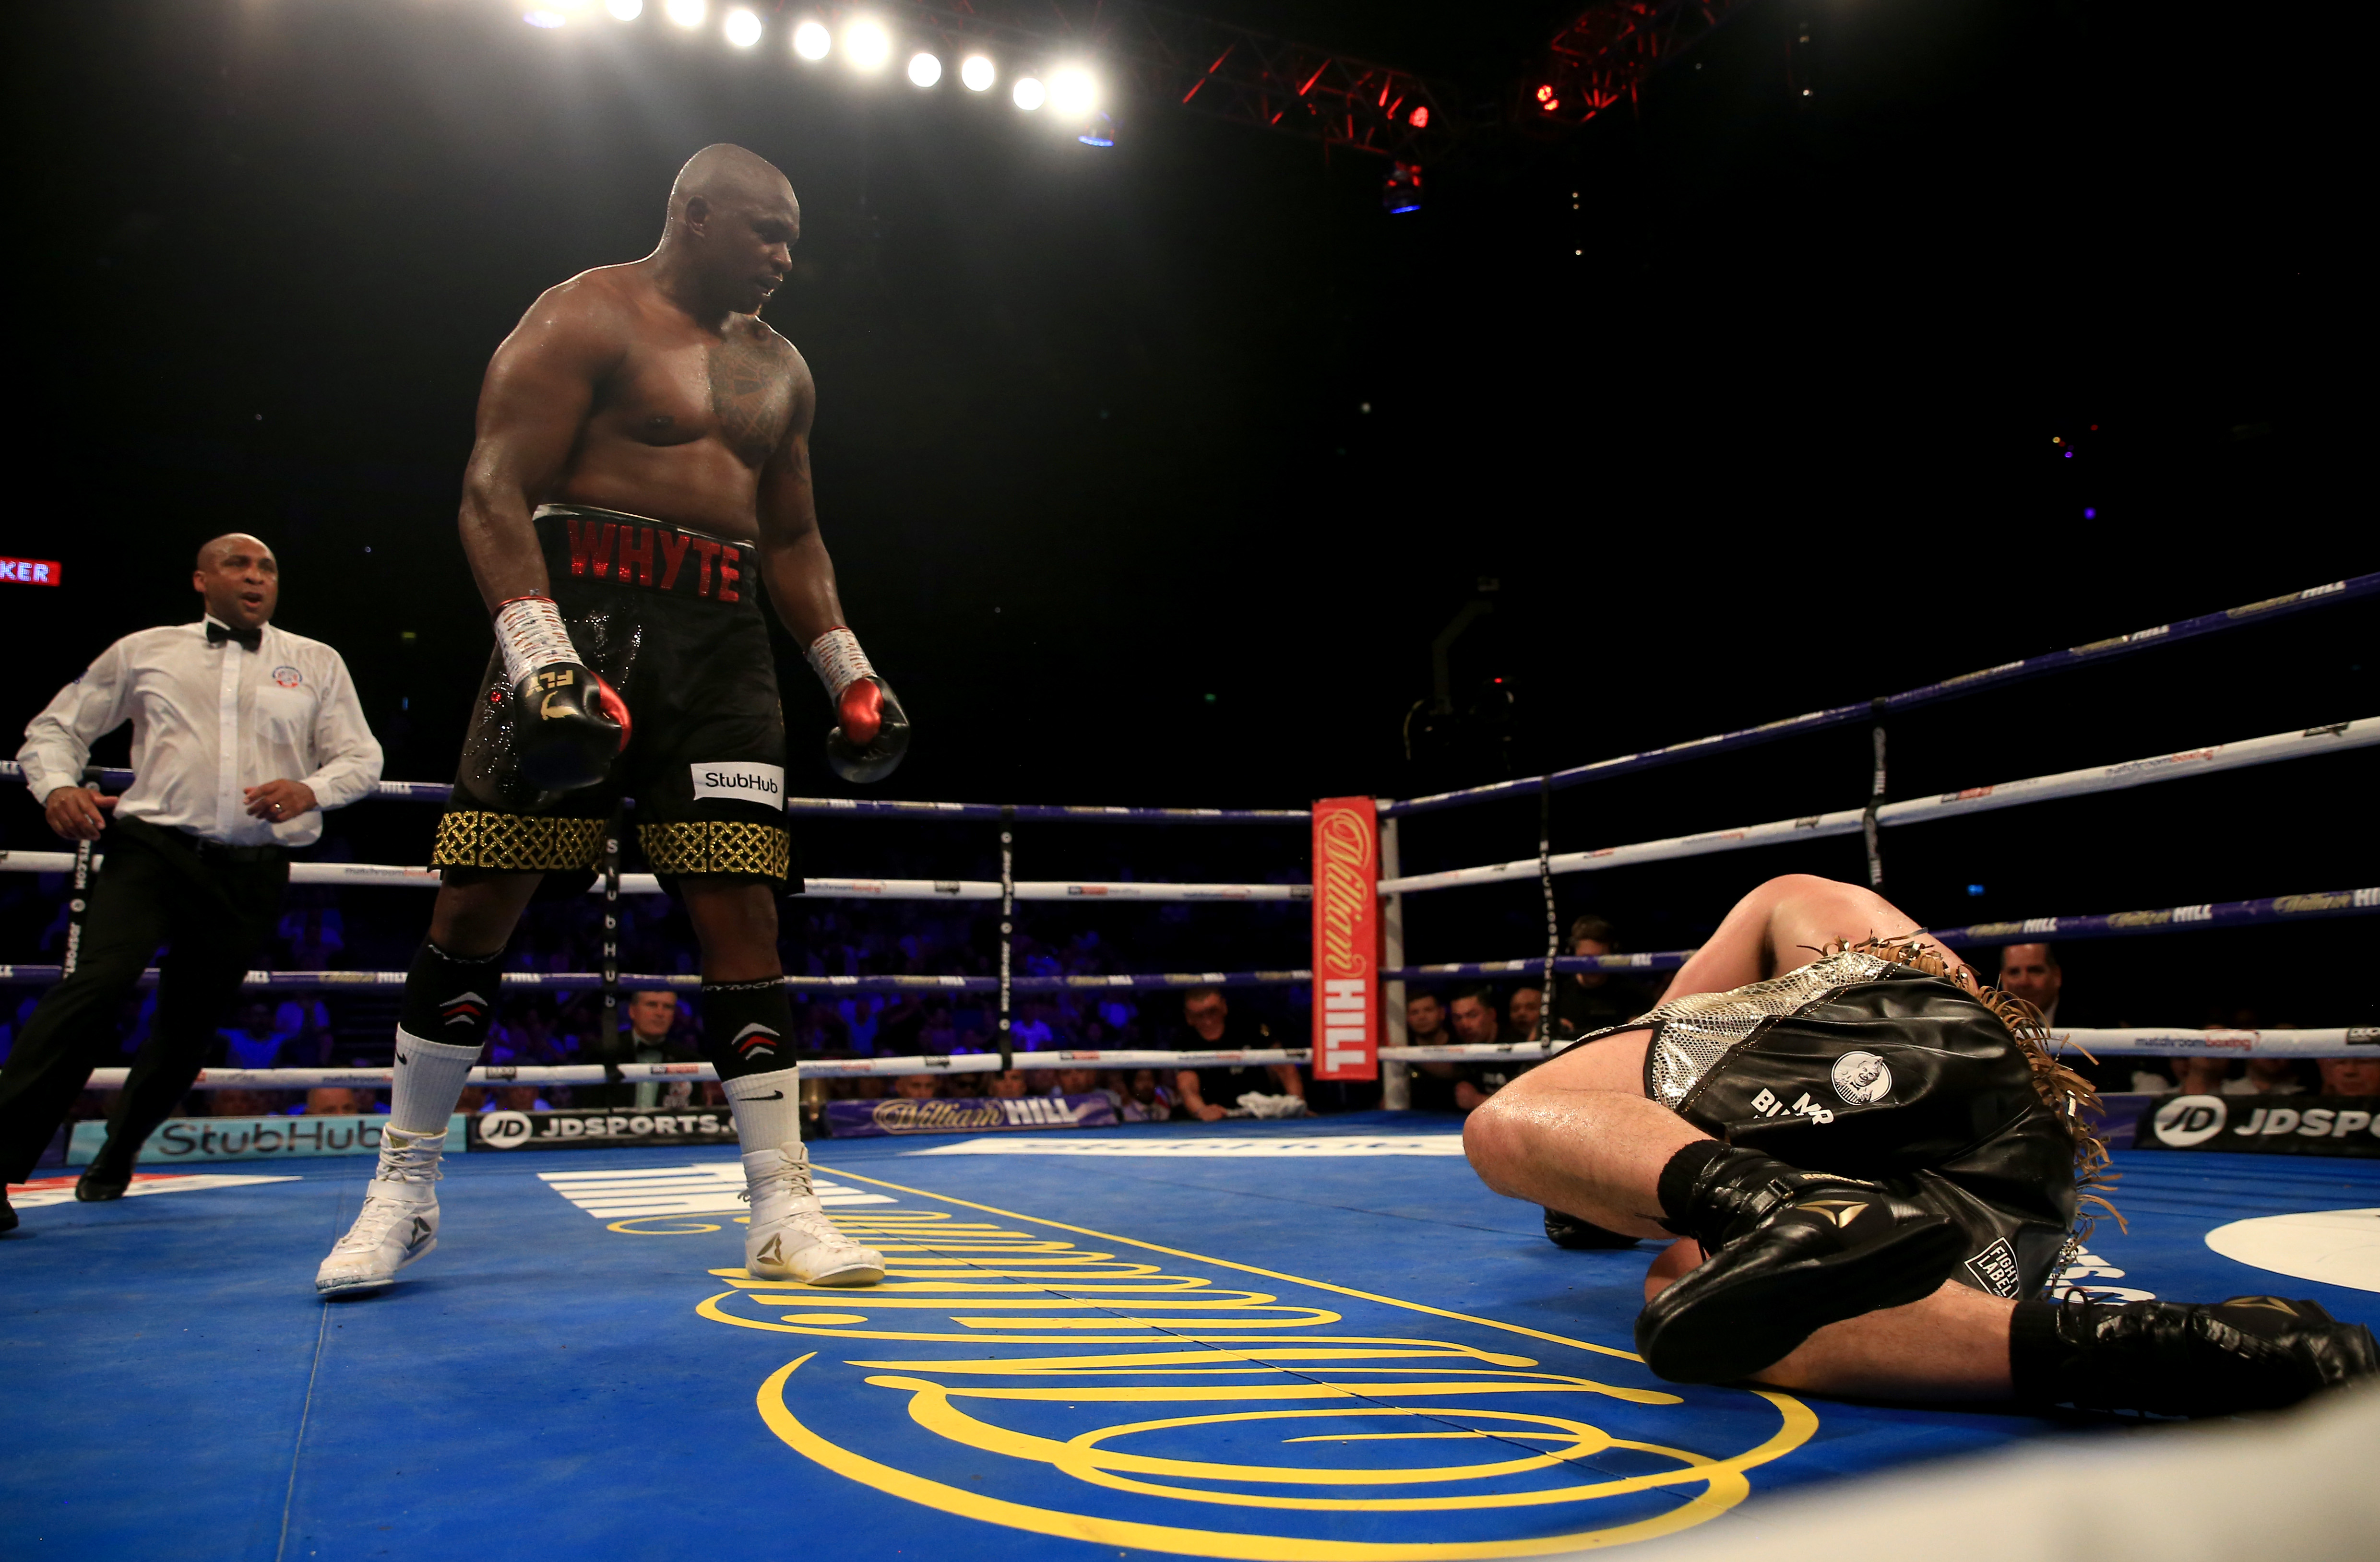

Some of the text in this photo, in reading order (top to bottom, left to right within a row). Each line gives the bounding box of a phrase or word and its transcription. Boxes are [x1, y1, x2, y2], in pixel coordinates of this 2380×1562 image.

[0, 560, 50, 582] KER
[567, 519, 739, 603] WHYTE
[525, 670, 573, 698] FLY
[705, 772, 778, 794] StubHub
[1324, 808, 1371, 1072] William HILL
[486, 1119, 525, 1138] JD
[872, 1098, 1079, 1133] William HILL
[2161, 1105, 2216, 1132] JD
[159, 1120, 384, 1156] StubHub
[1977, 1255, 2011, 1296] LABEL
[1989, 1246, 2019, 1284] FIGHT
